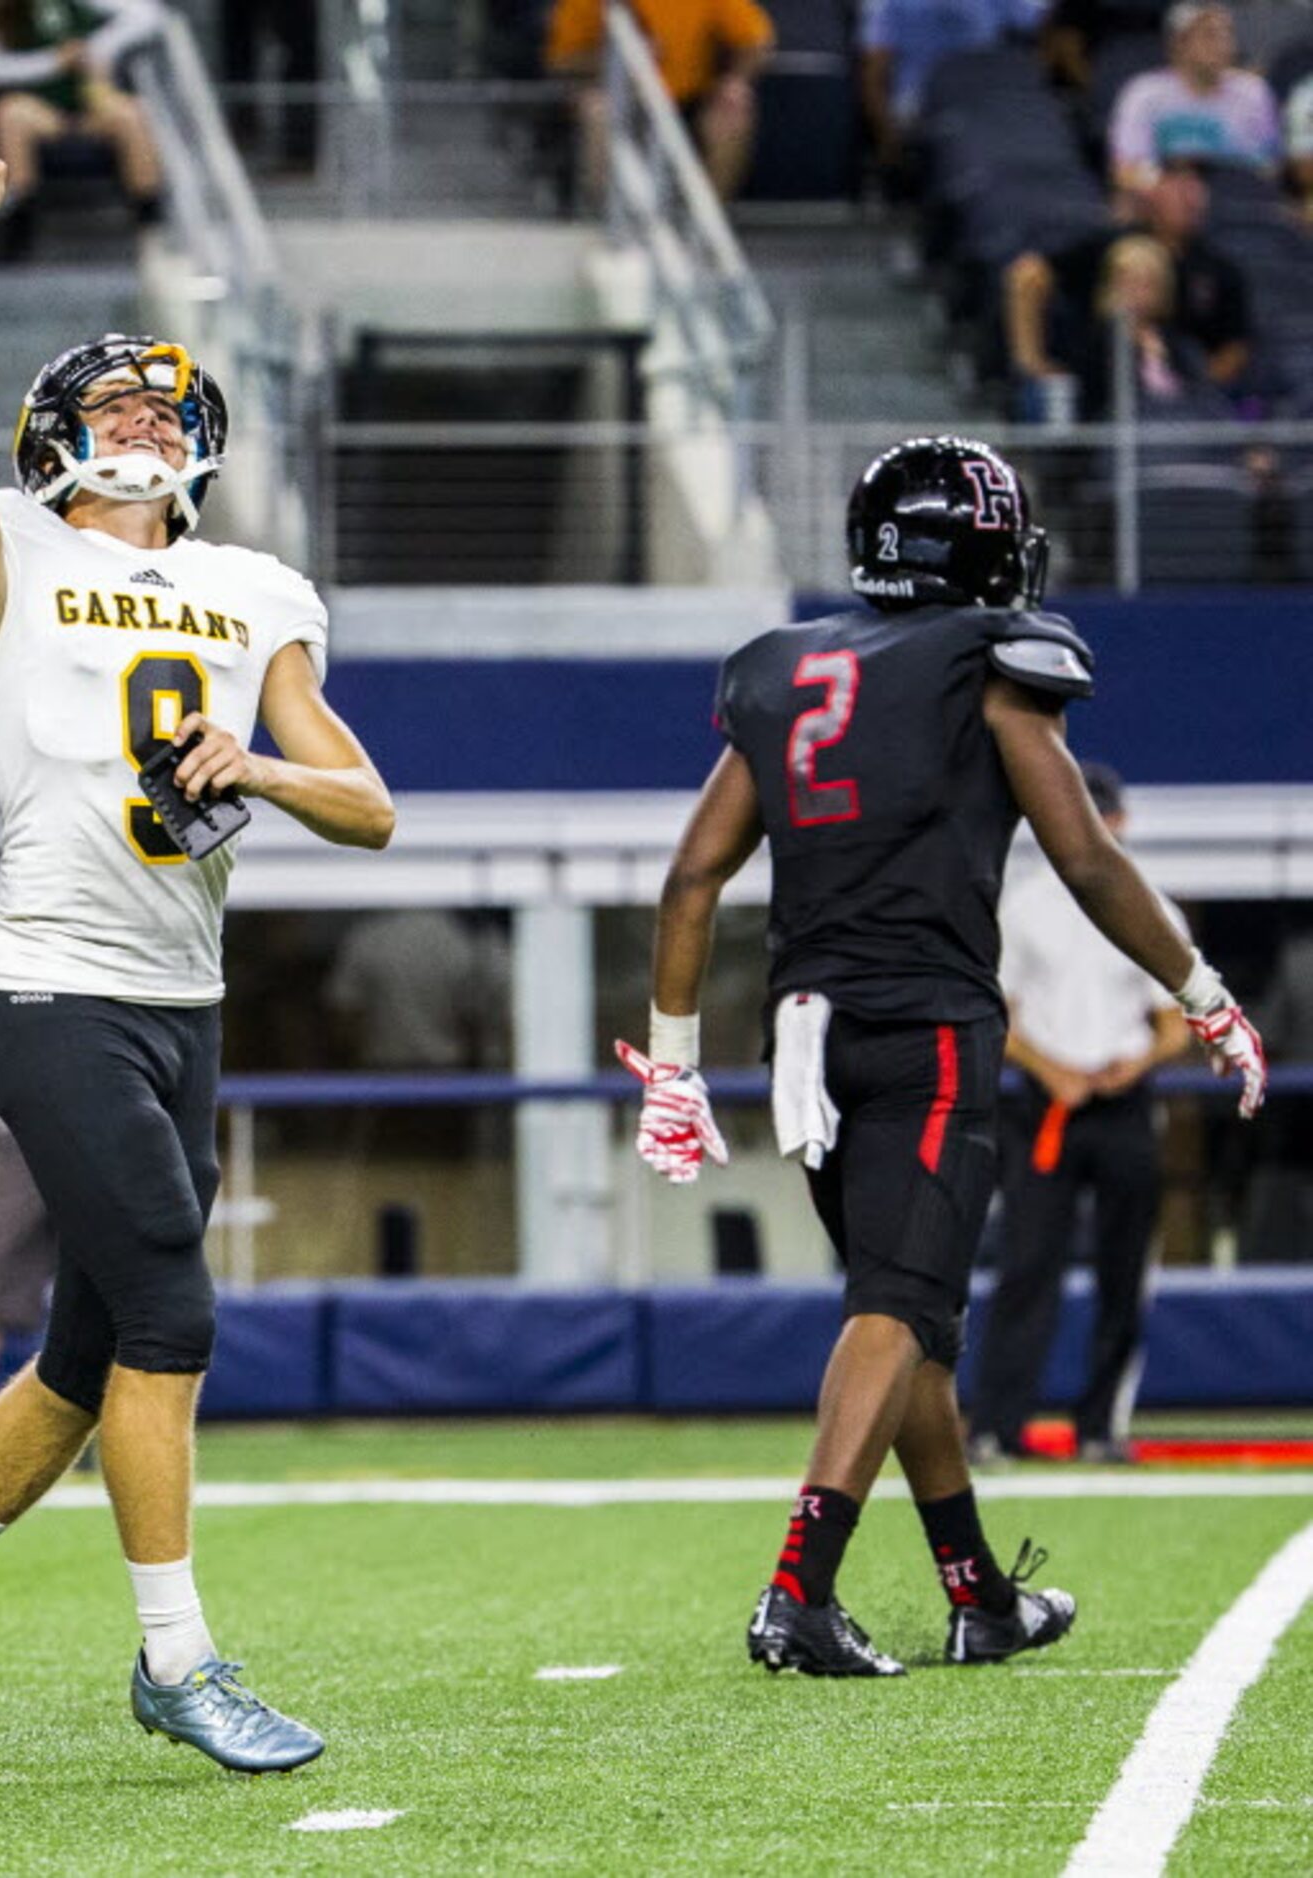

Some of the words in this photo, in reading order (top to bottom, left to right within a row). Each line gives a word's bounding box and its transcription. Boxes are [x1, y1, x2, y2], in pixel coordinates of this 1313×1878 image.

[962, 461, 1023, 531] H
[878, 522, 899, 561] 2
[54, 587, 252, 650] GARLAND
[119, 650, 212, 866] 9
[786, 648, 862, 827] 2
